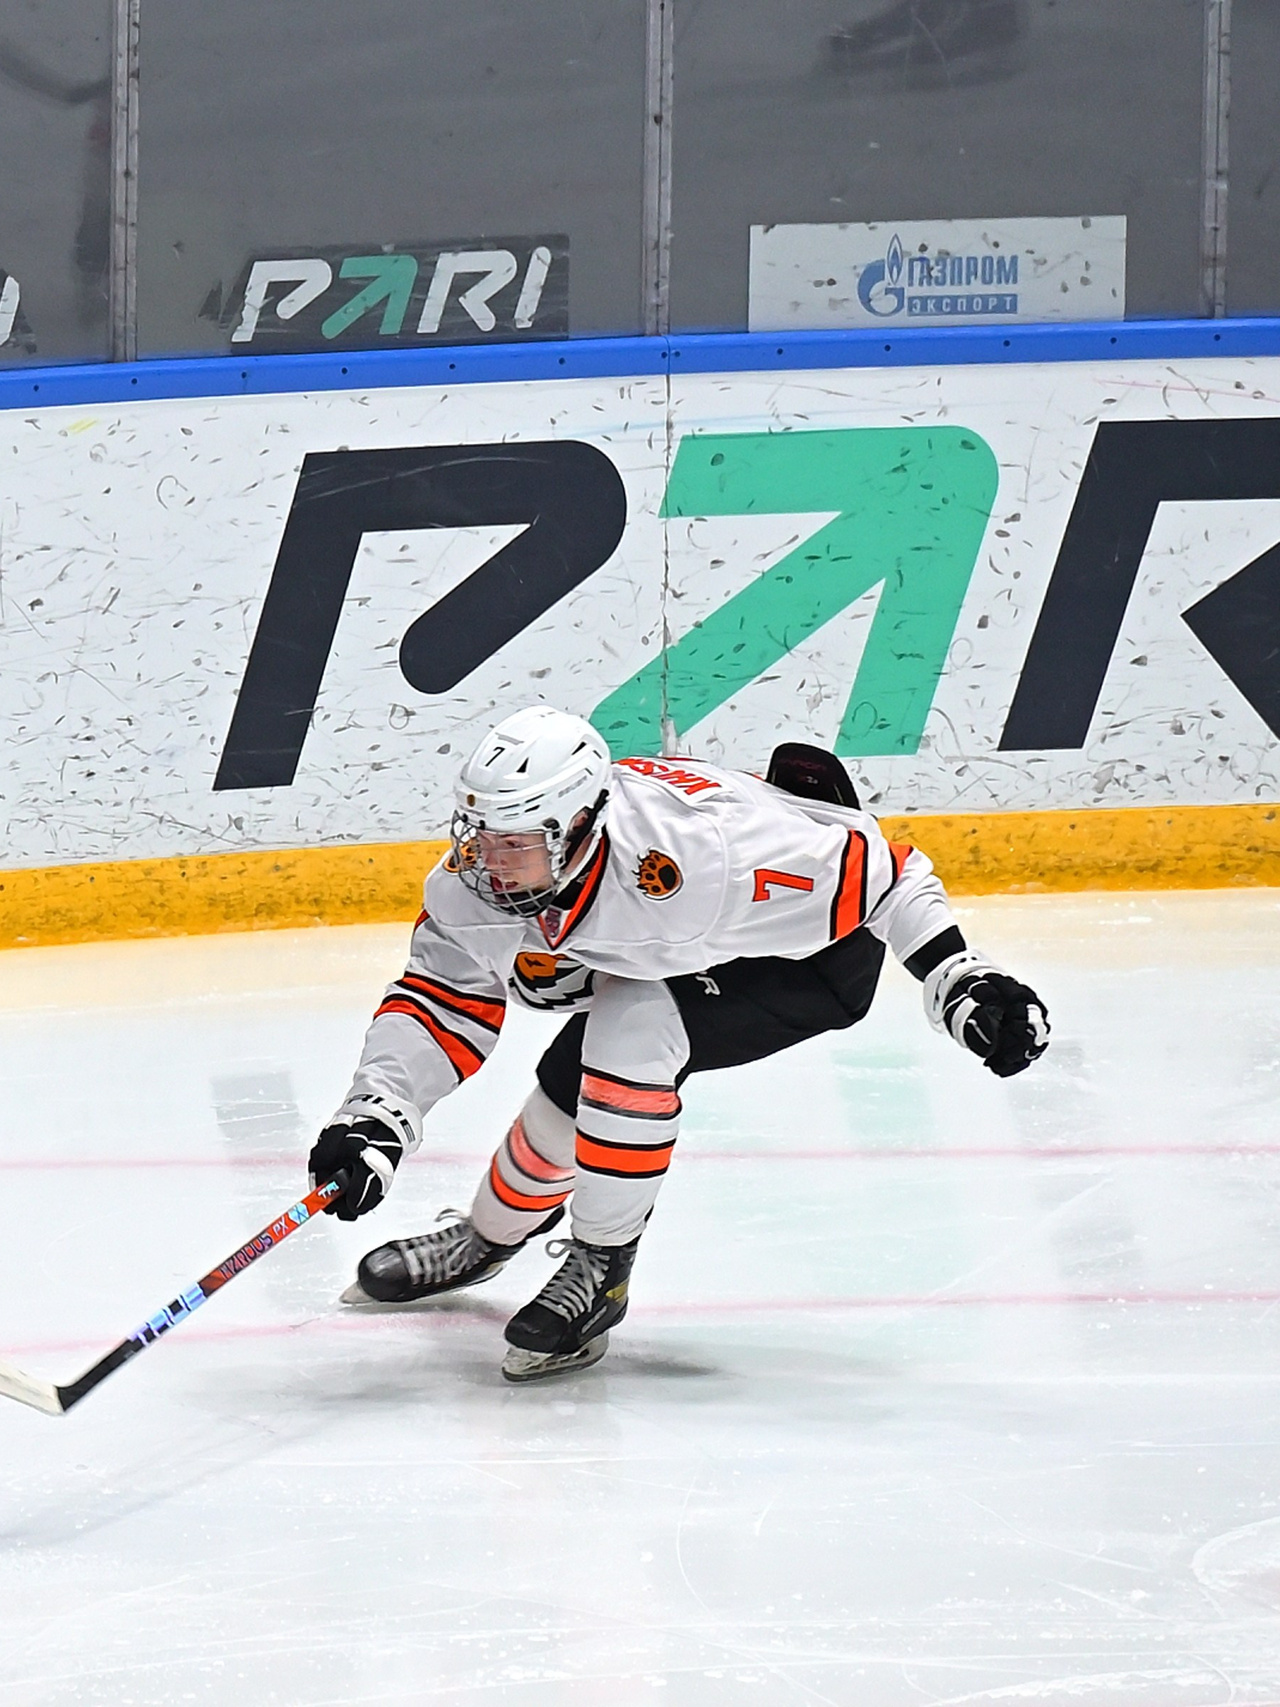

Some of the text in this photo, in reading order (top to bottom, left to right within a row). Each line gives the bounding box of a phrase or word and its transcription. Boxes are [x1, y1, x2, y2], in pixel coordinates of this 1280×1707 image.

[907, 254, 1019, 287] ГАЗПРОМ
[231, 245, 552, 343] PARI
[911, 296, 1014, 315] ЭКСПОРТ
[484, 746, 506, 768] 7
[751, 868, 814, 903] 7
